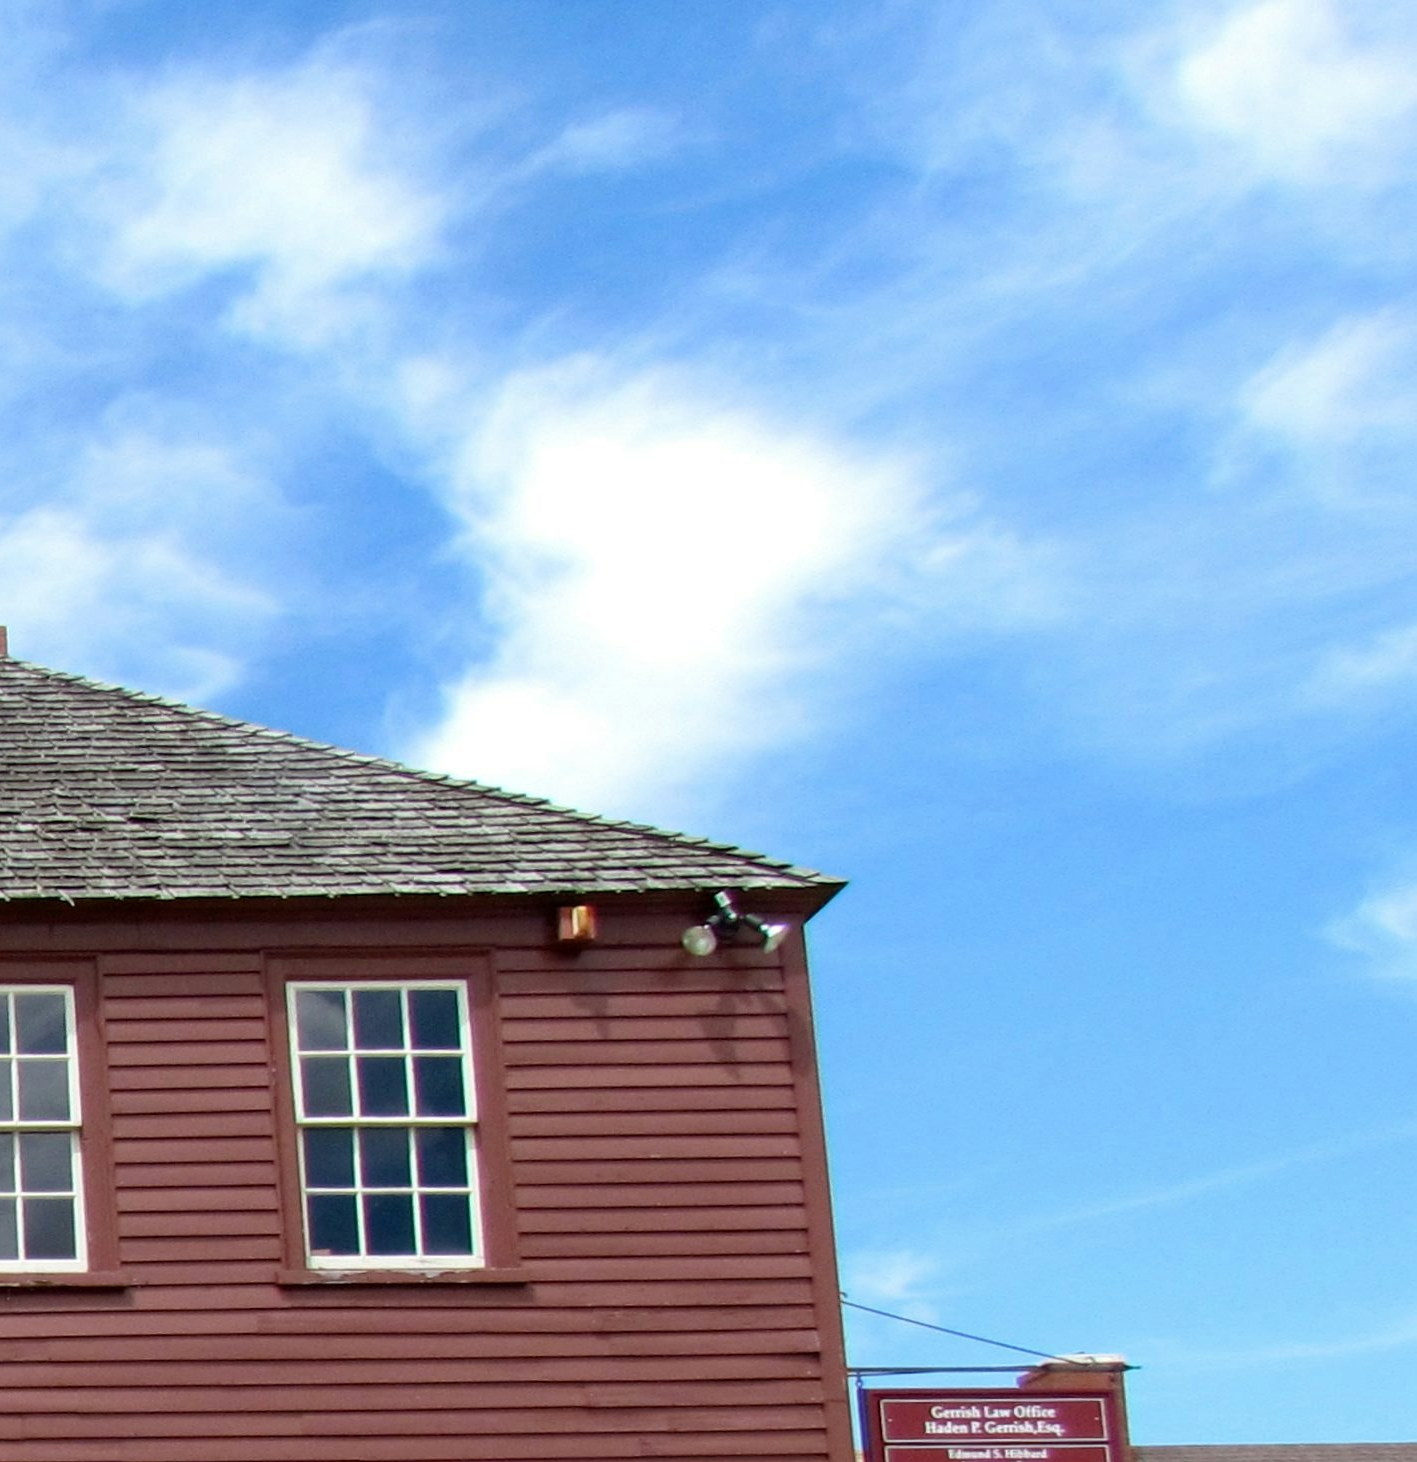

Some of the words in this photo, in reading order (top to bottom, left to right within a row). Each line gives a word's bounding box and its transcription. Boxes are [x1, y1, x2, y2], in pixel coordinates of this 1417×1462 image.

[931, 1406, 980, 1419] Gerrish
[984, 1406, 1010, 1418] Law
[1014, 1406, 1056, 1418] Office
[925, 1422, 968, 1434] Haden
[970, 1422, 982, 1434] P.
[948, 1450, 991, 1459] Edmund
[994, 1450, 1003, 1458] S.
[1005, 1449, 1048, 1458] Hibbard
